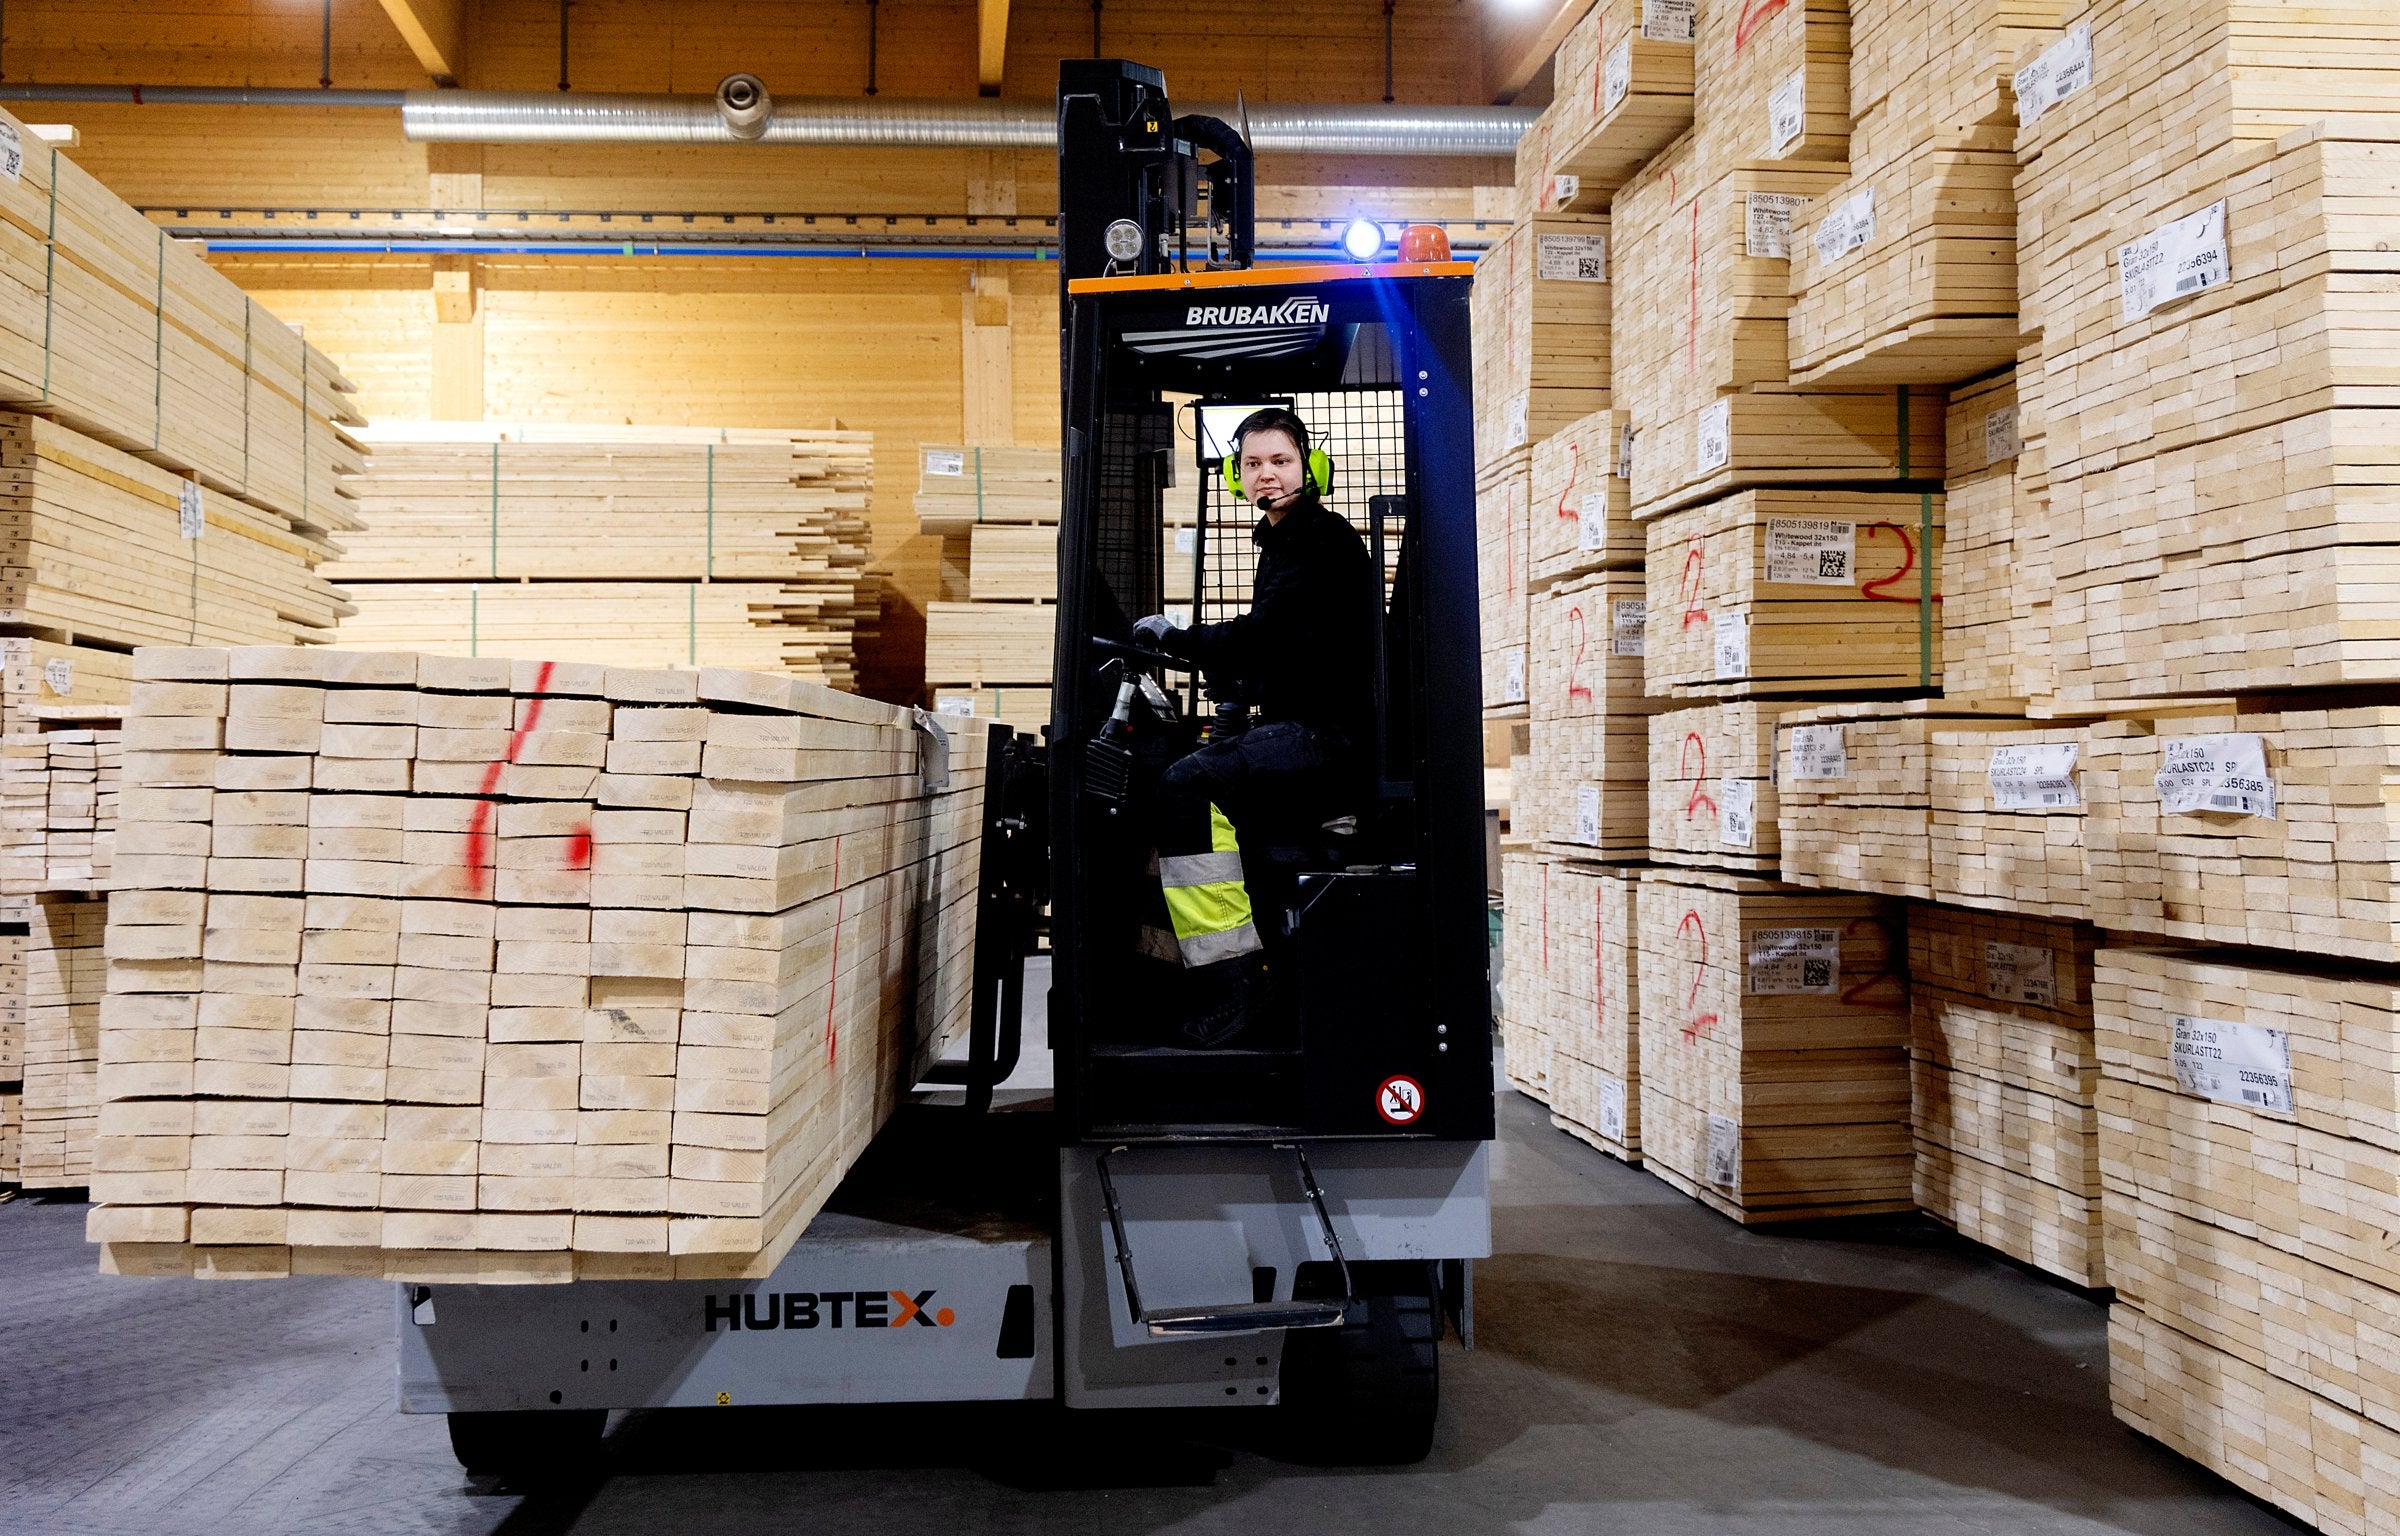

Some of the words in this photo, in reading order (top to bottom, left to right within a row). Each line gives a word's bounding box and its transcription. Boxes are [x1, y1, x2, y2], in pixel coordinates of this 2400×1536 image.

[1753, 194, 1805, 207] 8505139801
[1753, 208, 1790, 216] Whitewood
[1186, 296, 1330, 325] BRUBAKKEN
[1775, 520, 1830, 530] 8505139819
[1775, 532, 1813, 541] Whitewood
[1814, 534, 1838, 542] 32x150
[1862, 521, 1944, 605] 2
[2159, 762, 2215, 774] URLASTC24
[2182, 778, 2194, 786] C24
[1758, 930, 1813, 940] 8505139815
[2176, 1028, 2191, 1040] Gran
[2192, 1030, 2217, 1044] 32x150
[2174, 1043, 2222, 1060] SKURLASTT22
[2240, 1070, 2278, 1087] 22356395
[705, 1290, 937, 1332] HUBTEX
